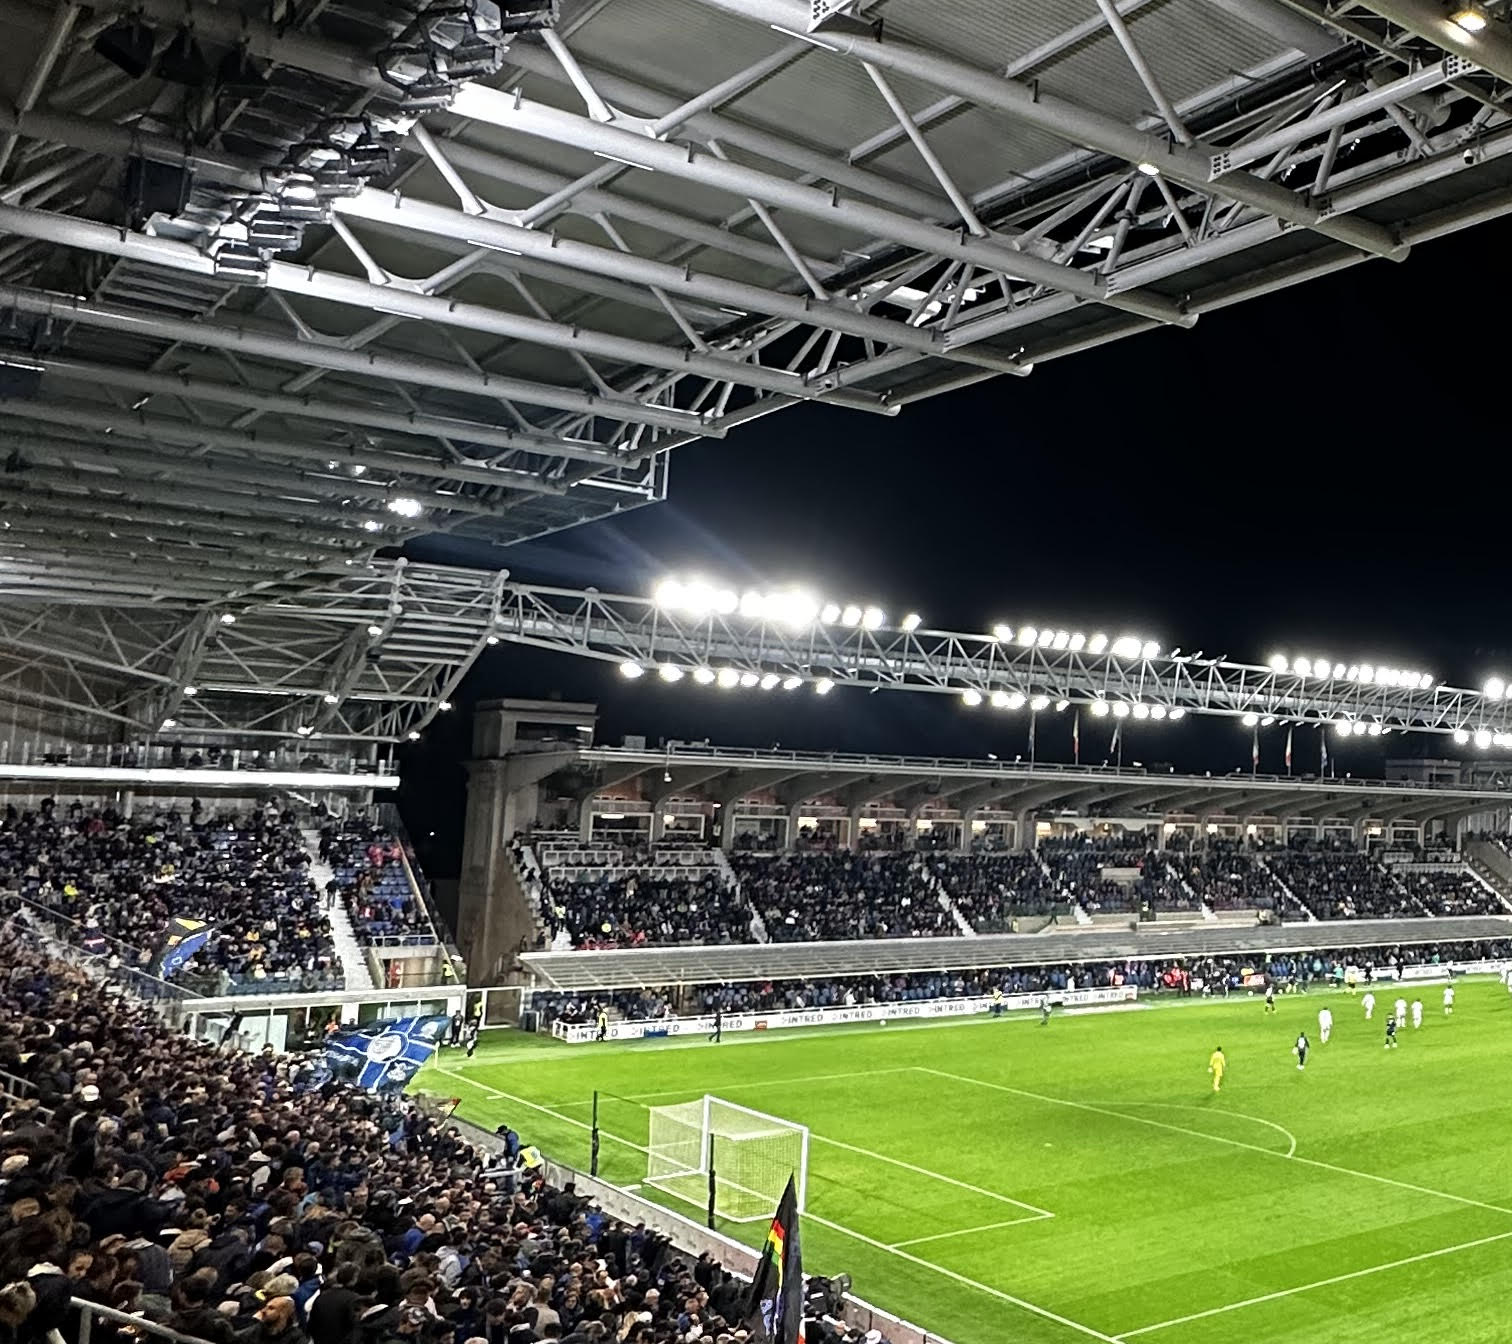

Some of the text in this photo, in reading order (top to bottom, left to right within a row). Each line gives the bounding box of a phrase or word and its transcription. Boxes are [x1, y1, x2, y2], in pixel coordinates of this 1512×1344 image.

[704, 1019, 742, 1030] INRED
[788, 1014, 824, 1024] INTRED
[839, 1010, 873, 1019] INTRED
[888, 1007, 920, 1016] INTRED
